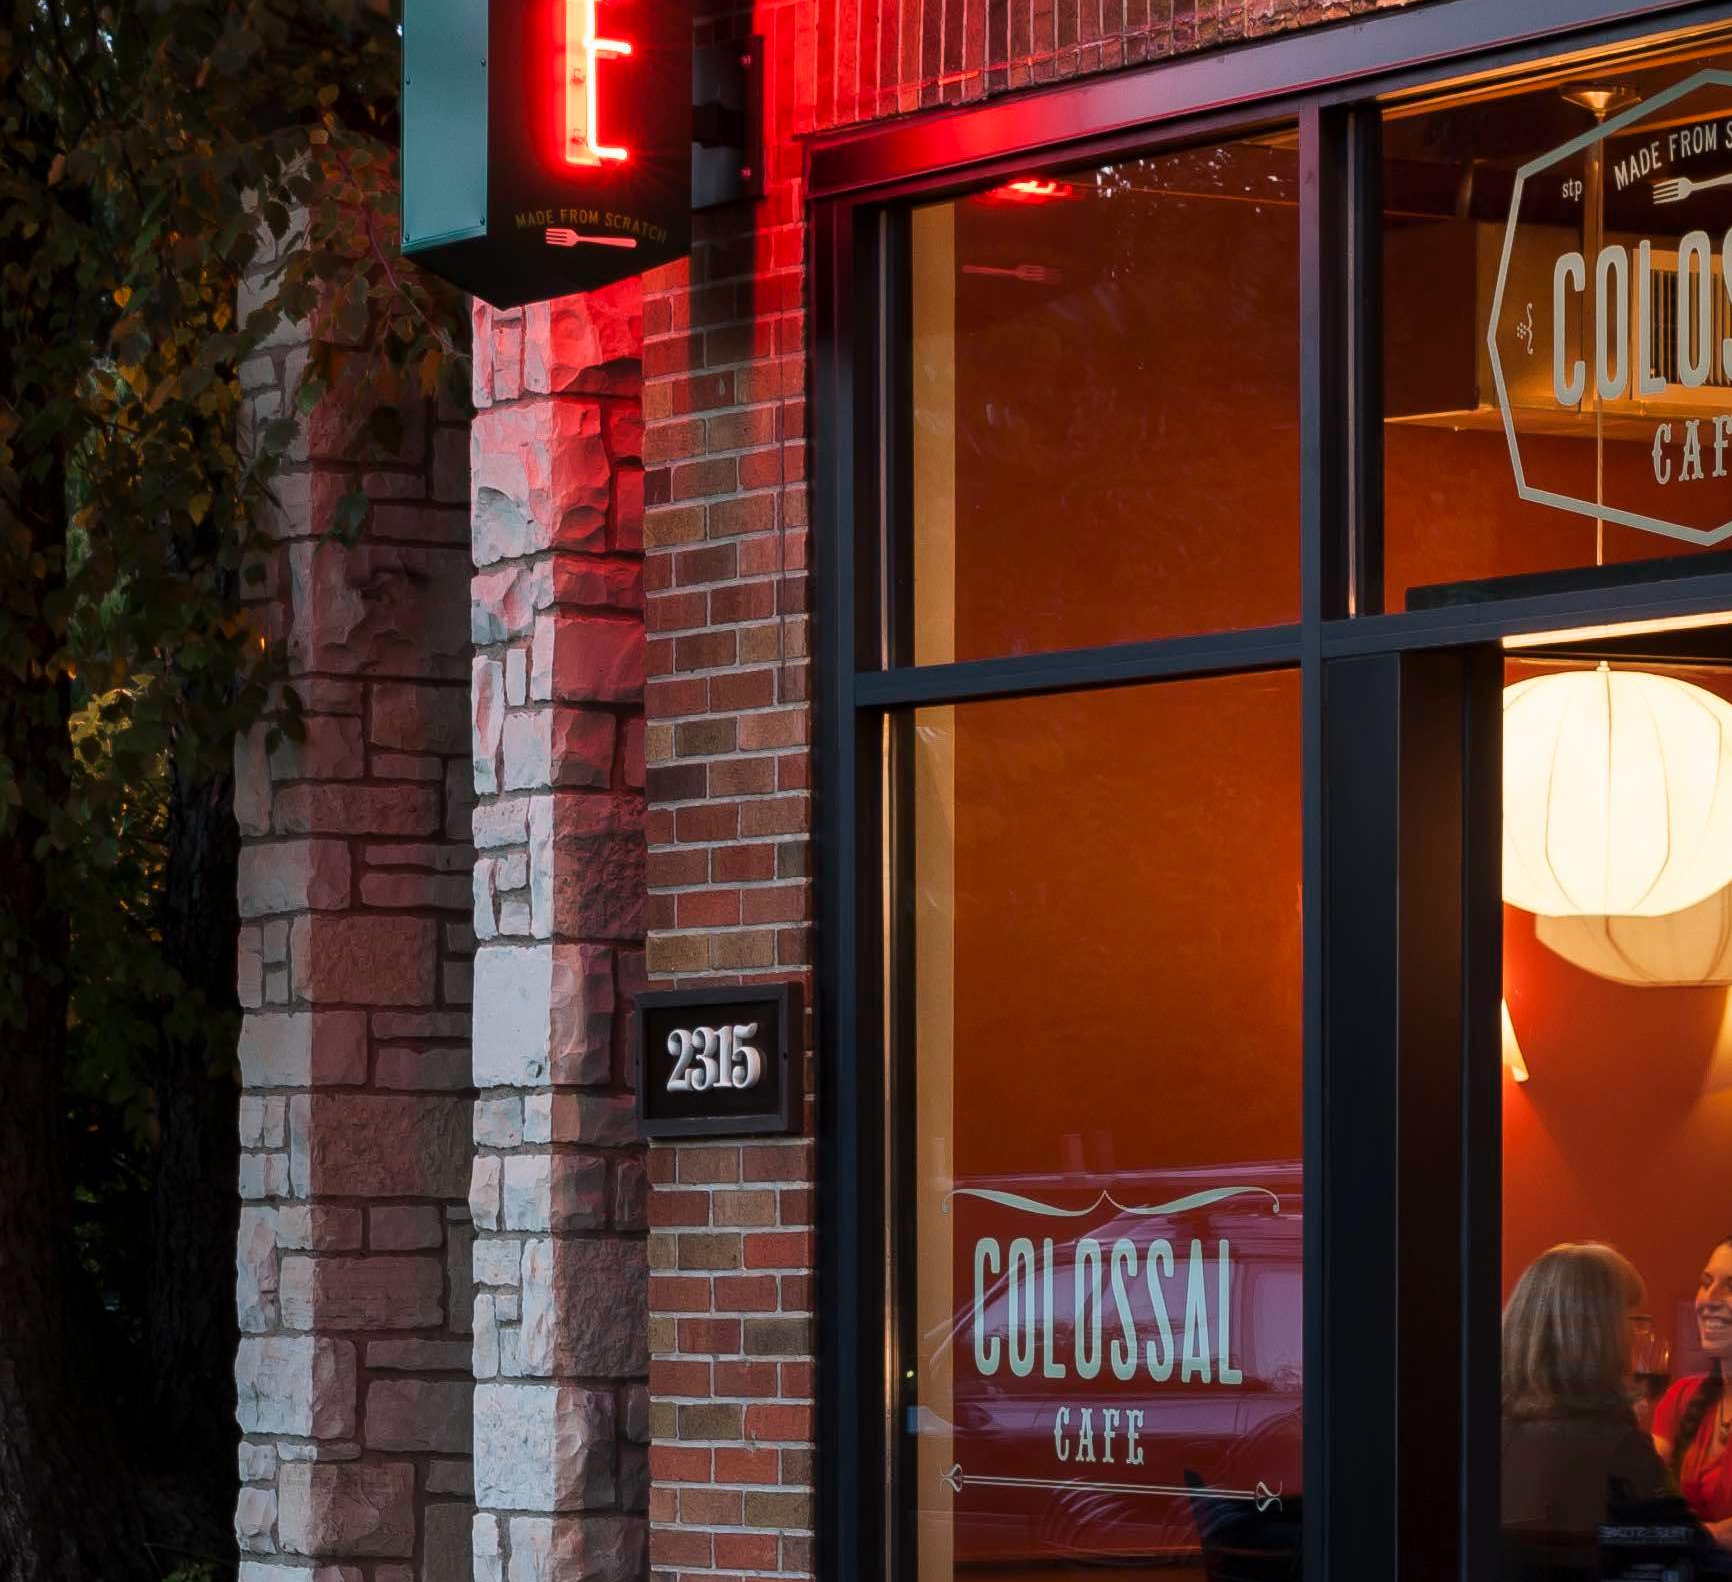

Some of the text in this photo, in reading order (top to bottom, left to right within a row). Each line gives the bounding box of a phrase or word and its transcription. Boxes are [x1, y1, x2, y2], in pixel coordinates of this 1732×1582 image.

[1614, 141, 1662, 191] MADE
[1668, 123, 1717, 162] FROM
[1562, 177, 1582, 201] stp
[515, 209, 668, 244] MADE FROM SCRATCH
[666, 1022, 761, 1092] 2315
[974, 1237, 1243, 1385] COLOSSAL
[1054, 1406, 1145, 1465] CAFE
